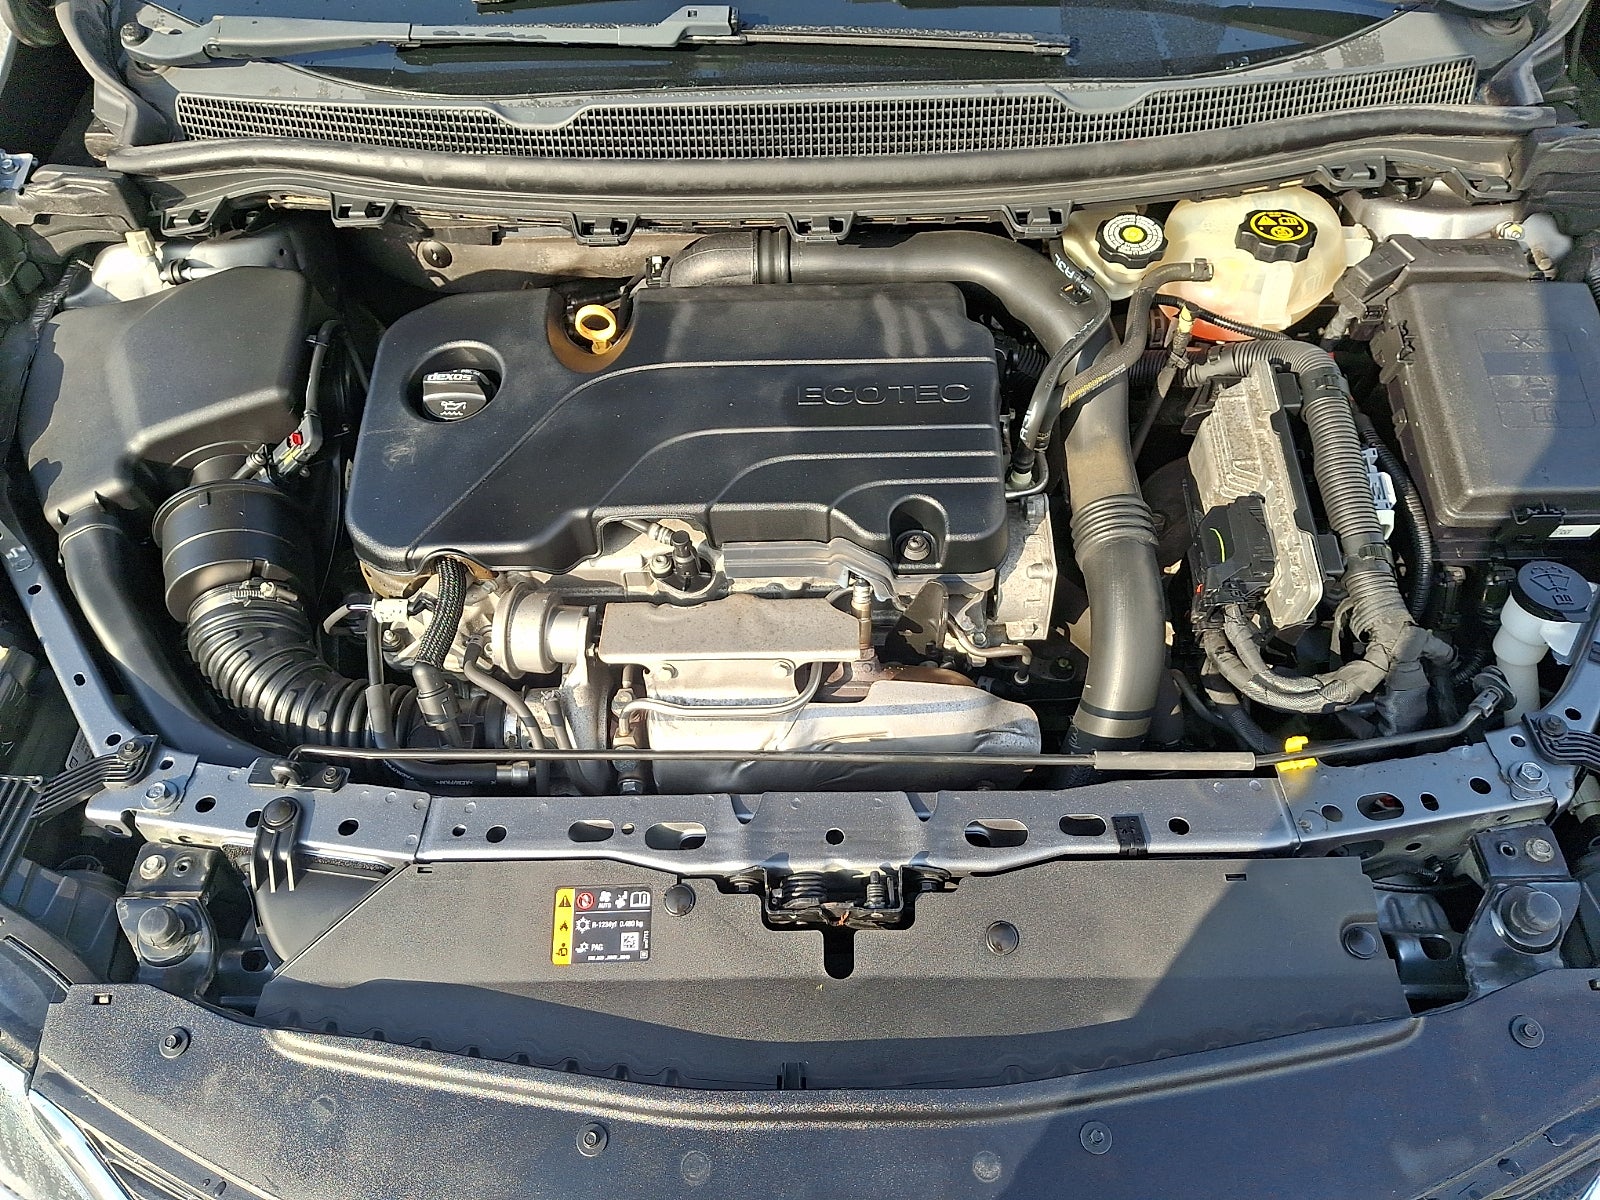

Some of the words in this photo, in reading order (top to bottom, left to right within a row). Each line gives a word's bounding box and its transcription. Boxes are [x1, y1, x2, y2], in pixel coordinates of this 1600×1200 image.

[427, 372, 473, 381] dexos
[798, 384, 970, 405] ECOTEC
[591, 943, 604, 951] PAG
